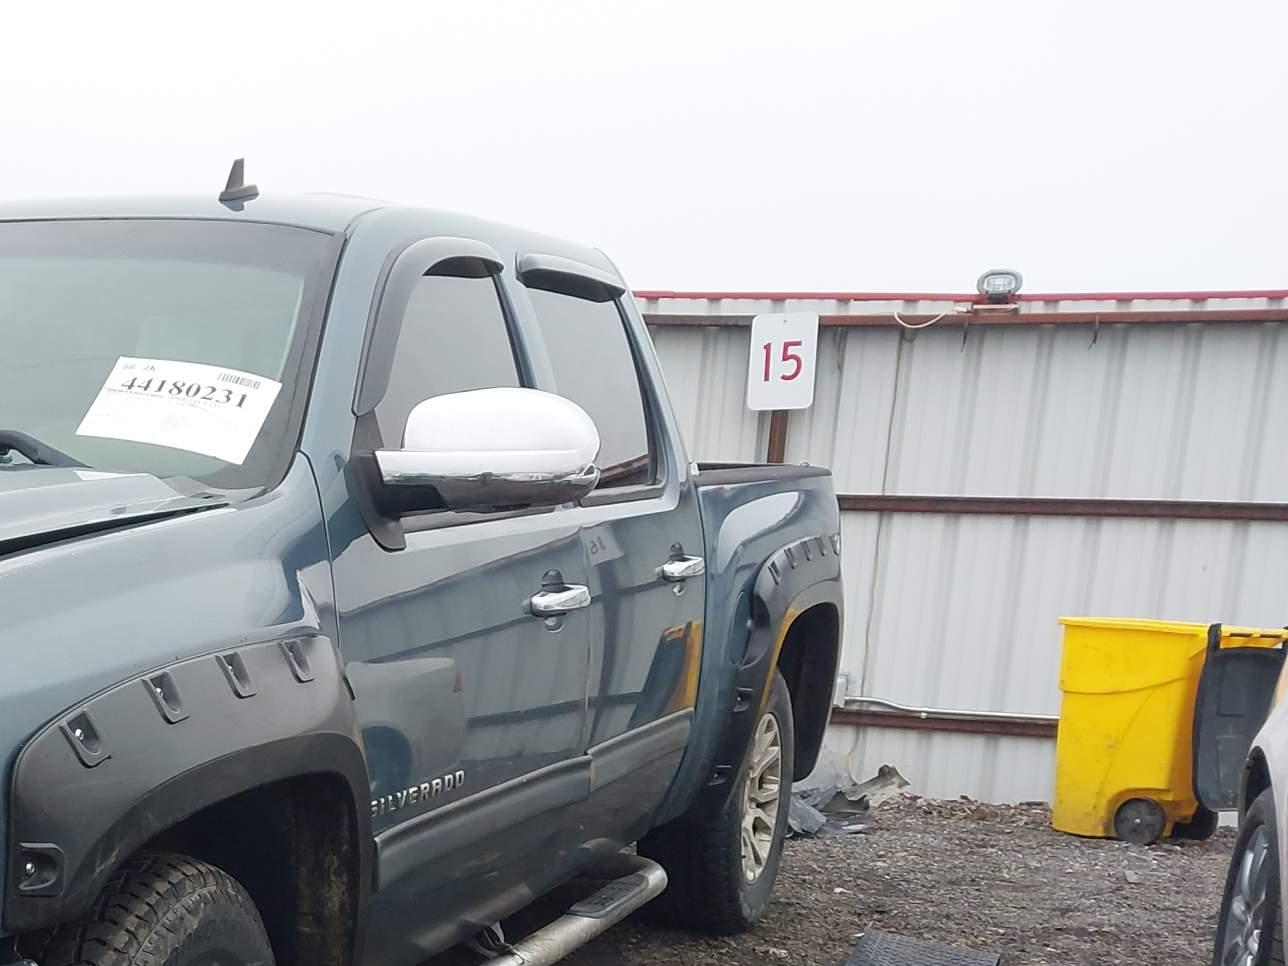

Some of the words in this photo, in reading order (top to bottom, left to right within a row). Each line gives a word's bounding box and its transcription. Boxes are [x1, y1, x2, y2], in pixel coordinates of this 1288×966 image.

[762, 340, 803, 382] 15
[121, 376, 248, 408] 44180231
[369, 769, 465, 818] SILVERADO
